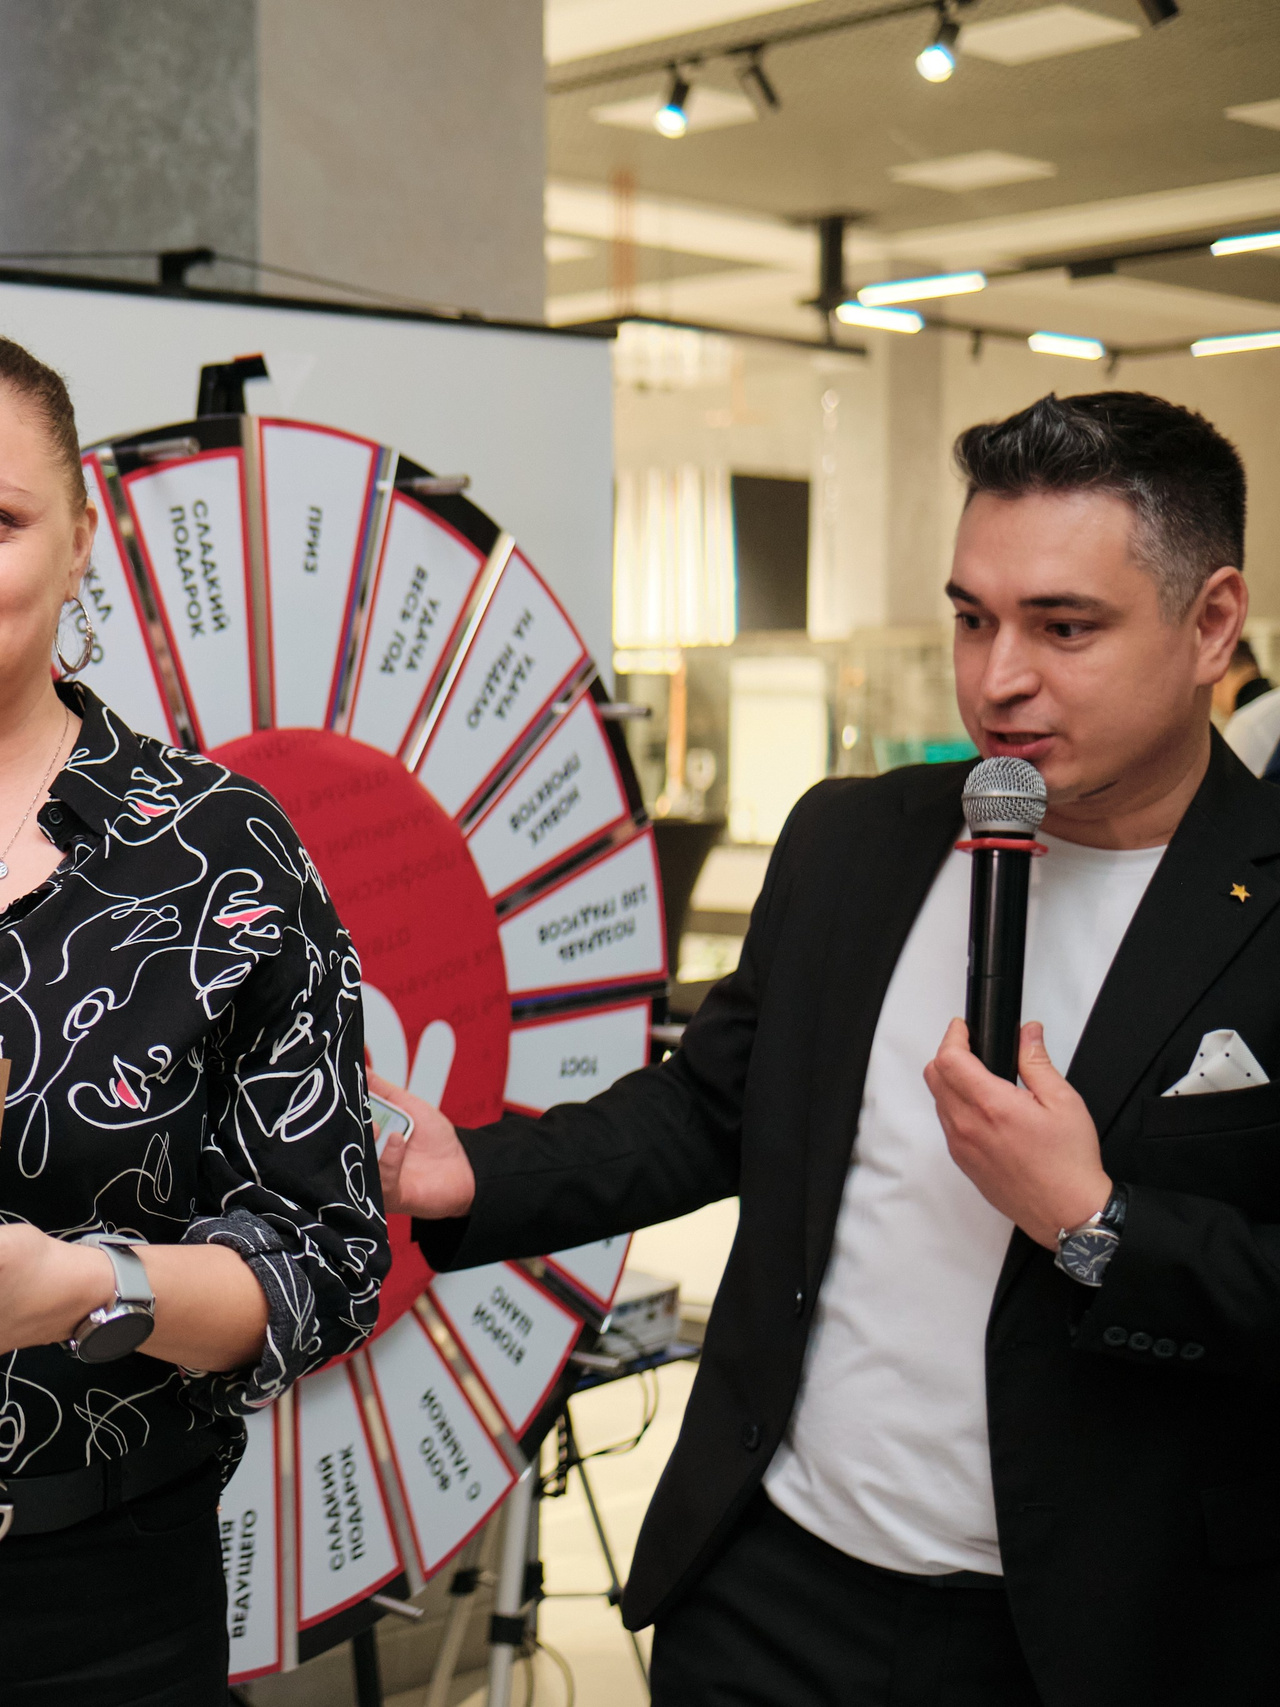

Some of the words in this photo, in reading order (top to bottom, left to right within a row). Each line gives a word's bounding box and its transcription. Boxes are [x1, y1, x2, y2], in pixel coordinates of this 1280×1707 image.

[169, 505, 205, 638] ПОДАРОК
[193, 499, 230, 632] СЛАДКИЙ
[304, 505, 322, 574] ПРИЗ
[400, 565, 428, 621] ВЕСЬ
[513, 608, 534, 639] НА
[380, 630, 406, 673] ГОД
[405, 598, 441, 671] УДАЧА
[467, 642, 515, 729] НЕДЕЛЮ
[494, 654, 534, 719] УДАЧА
[510, 752, 580, 832] ПРОЕКТОВ
[529, 785, 579, 844] НОВЫХ
[538, 898, 616, 944] ГРАДУСОВ
[560, 1056, 598, 1077] ТОСТ
[472, 1302, 526, 1365] ВТОРОЙ
[491, 1286, 533, 1336] ШАНС
[420, 1387, 470, 1482] УЛЫБКОЙ
[420, 1437, 450, 1491] ФОТО
[316, 1454, 345, 1571] СЛАДКИЙ
[338, 1443, 365, 1560] ПОДАРОК
[466, 1481, 481, 1500] С
[232, 1509, 257, 1638] ВЕДУЩЕГО
